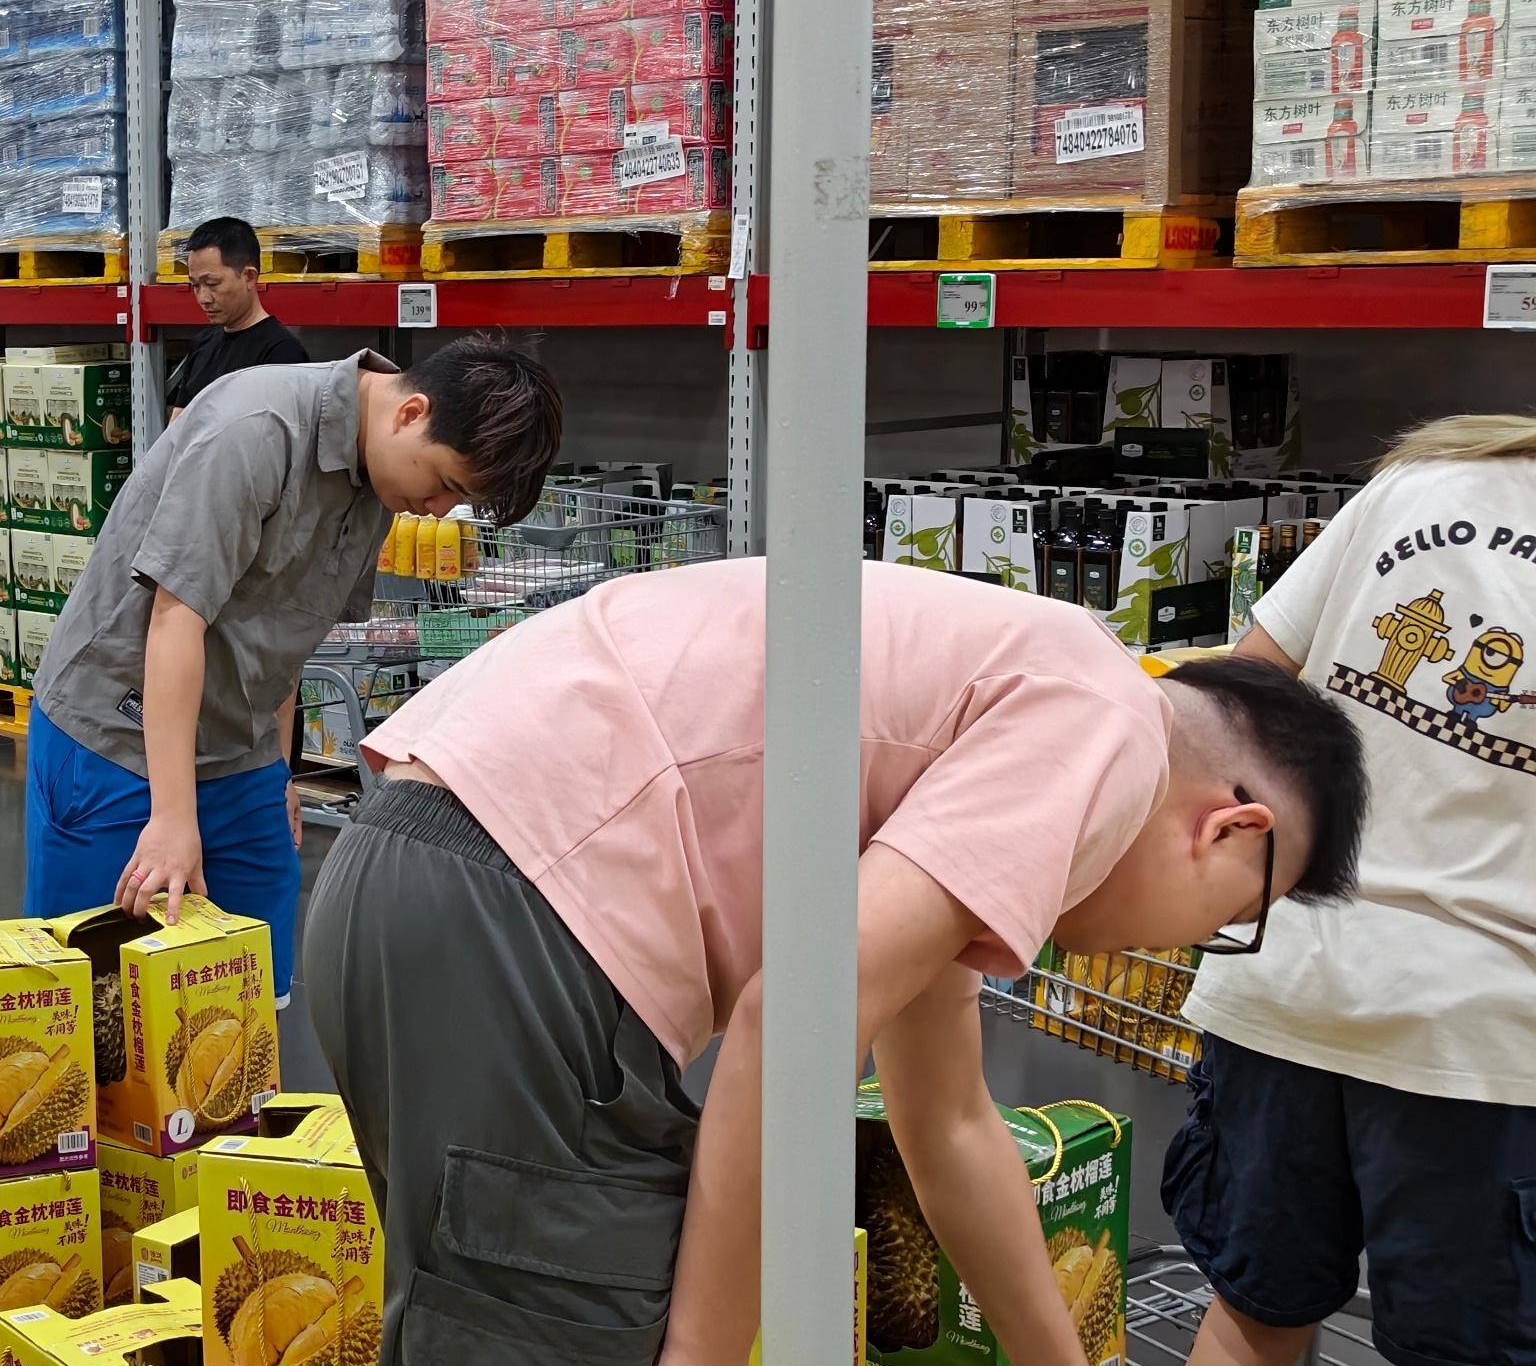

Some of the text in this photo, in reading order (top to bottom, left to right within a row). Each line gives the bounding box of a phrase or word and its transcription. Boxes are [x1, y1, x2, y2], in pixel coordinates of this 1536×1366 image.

[1264, 102, 1322, 122] 东方树叶
[1387, 91, 1447, 111] 东方树叶
[1056, 122, 1138, 157] 74840422784076
[1376, 520, 1536, 577] BELLO PA
[128, 961, 147, 1074] 即食金枕榴莲
[172, 1115, 192, 1140] L
[226, 1188, 367, 1227] 即食金枕榴莲
